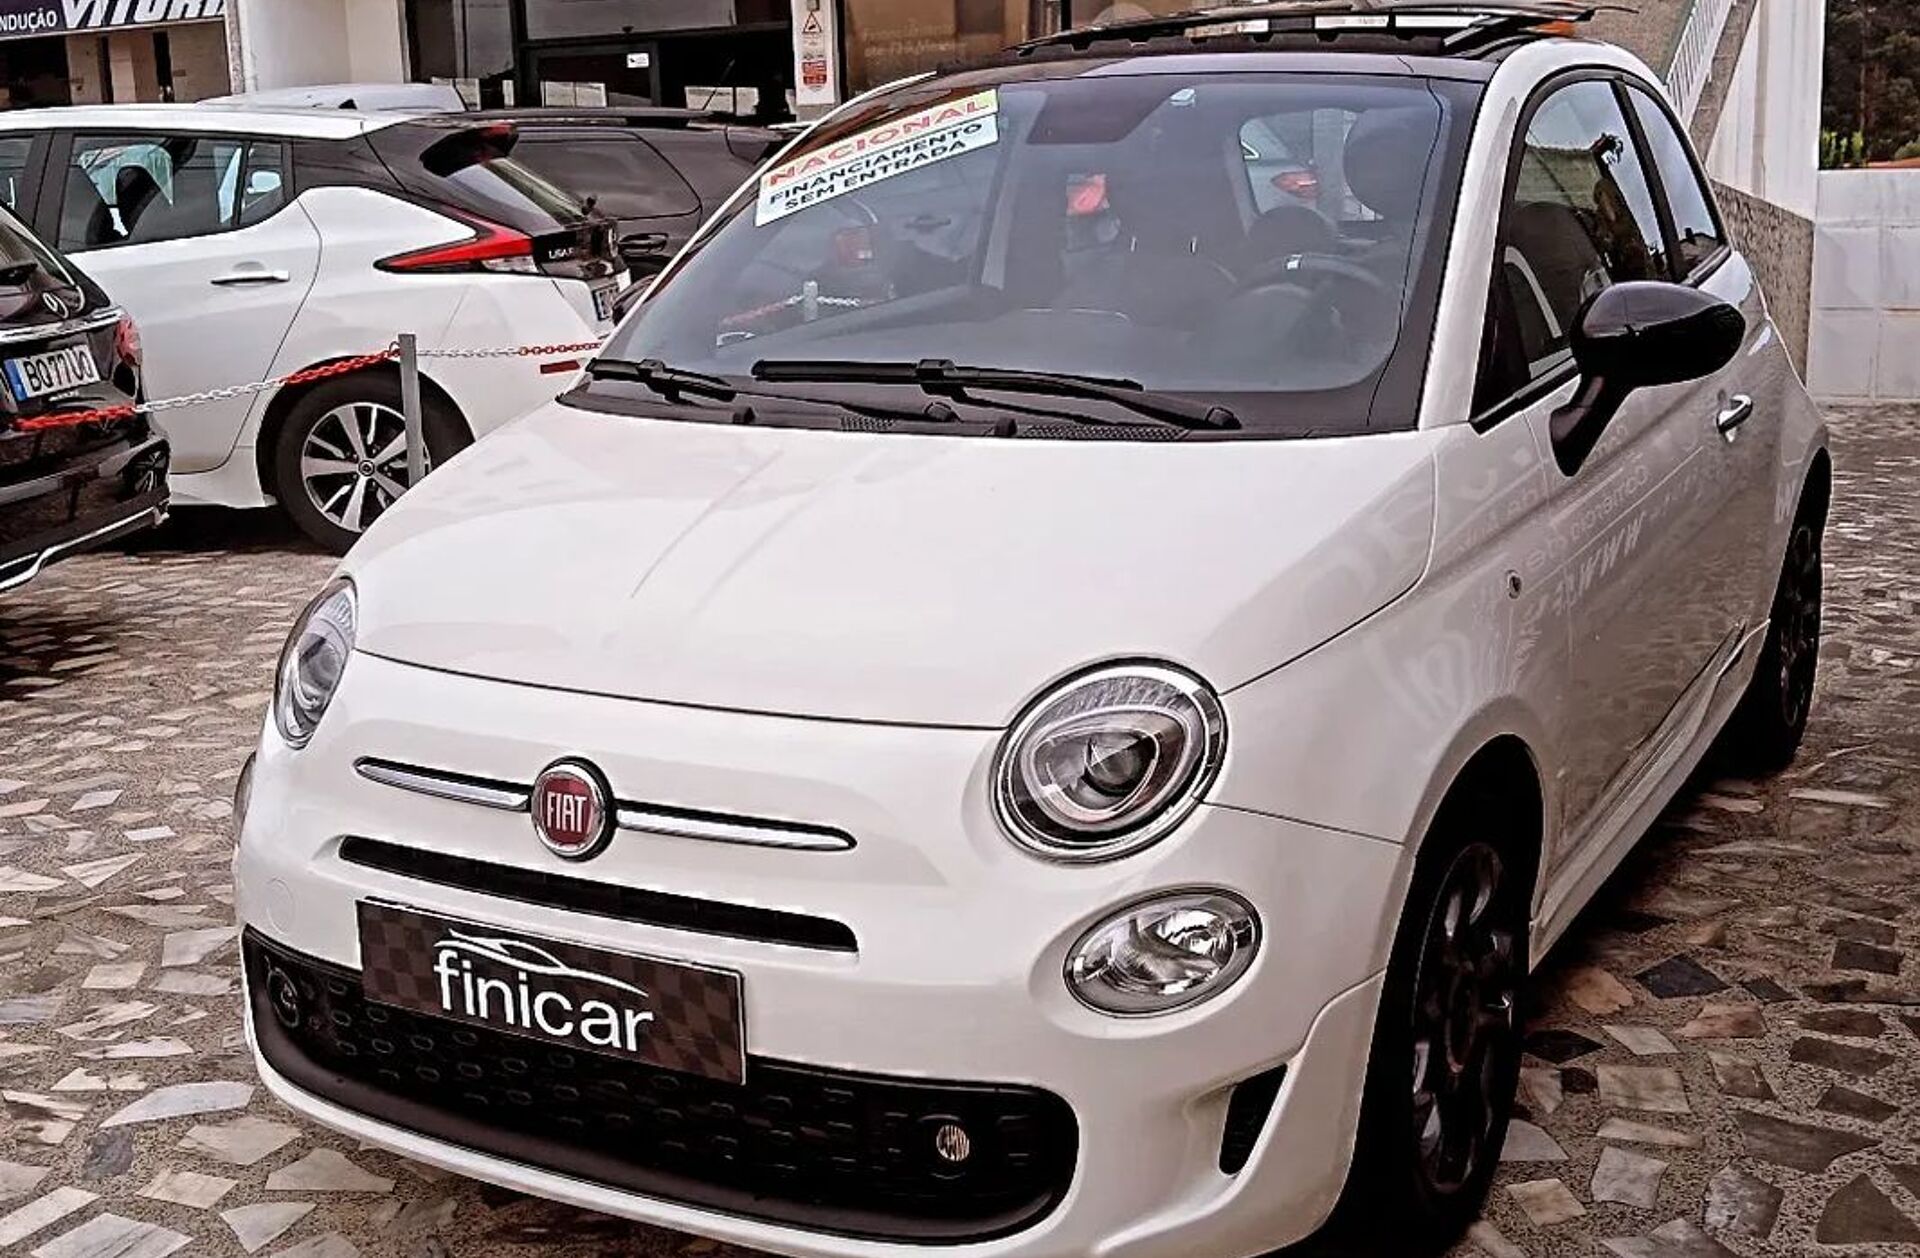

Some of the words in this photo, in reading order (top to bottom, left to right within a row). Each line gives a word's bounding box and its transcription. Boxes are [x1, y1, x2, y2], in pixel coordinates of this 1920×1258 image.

[769, 100, 989, 186] NACIONAL
[769, 122, 983, 205] FINANCIAMENTO
[784, 183, 836, 210] SEM
[843, 140, 967, 188] ENTRADA
[546, 790, 587, 833] FIAT
[433, 948, 655, 1053] finicar
